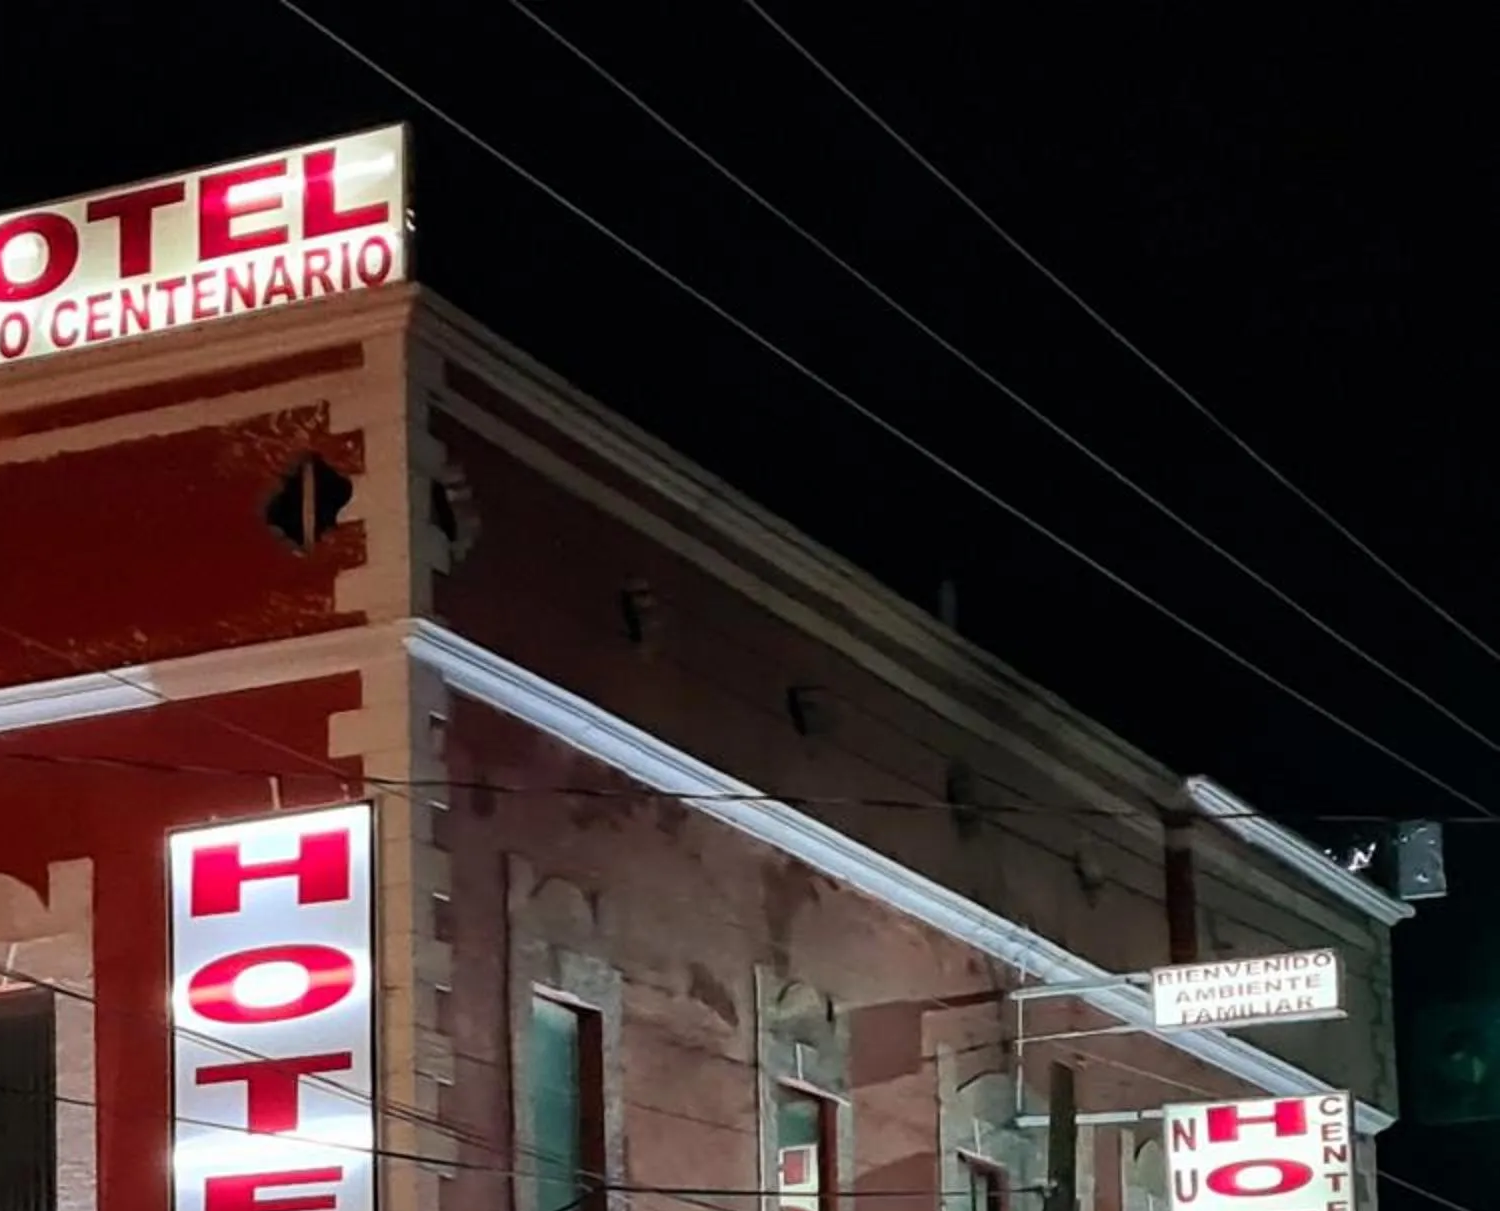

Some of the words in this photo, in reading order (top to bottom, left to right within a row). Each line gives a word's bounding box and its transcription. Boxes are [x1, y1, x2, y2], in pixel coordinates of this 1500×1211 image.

[49, 235, 393, 348] CENTENARIO
[1157, 952, 1332, 987] BIENVENIDO
[1175, 973, 1321, 1004] AMBIENTE
[1181, 995, 1314, 1025] FAMILIAR
